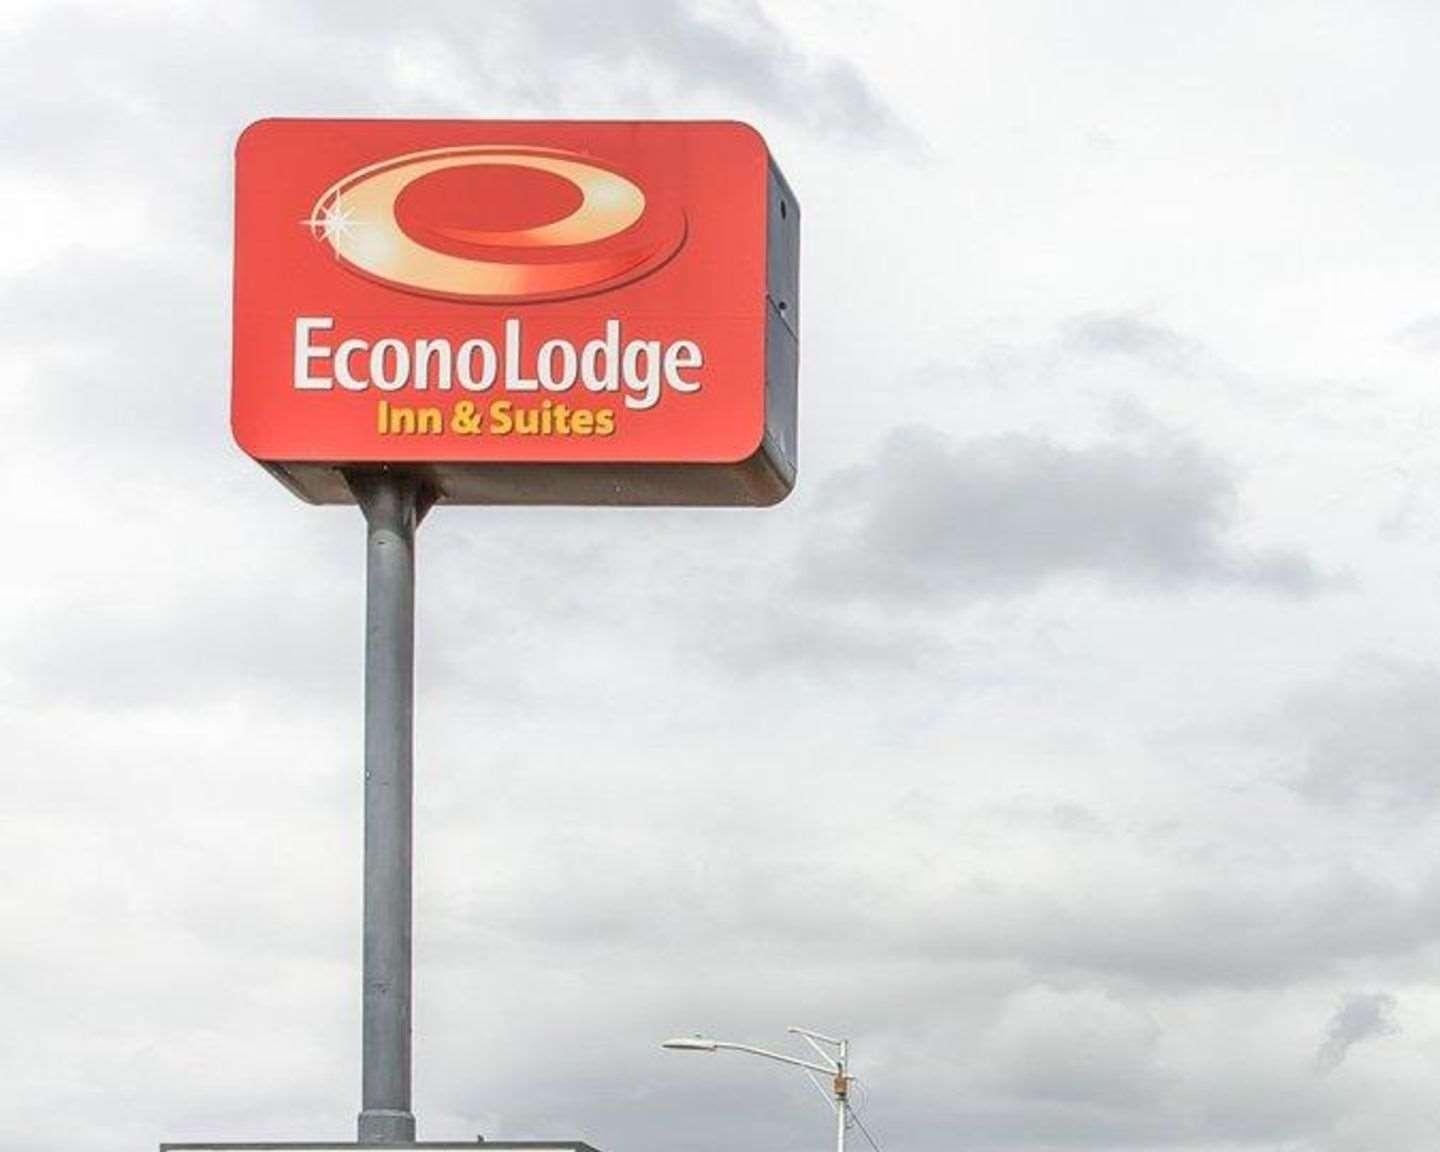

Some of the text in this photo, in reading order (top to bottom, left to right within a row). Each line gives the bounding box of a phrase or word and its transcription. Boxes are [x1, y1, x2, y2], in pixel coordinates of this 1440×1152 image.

[377, 401, 616, 436] Inn & Suites
